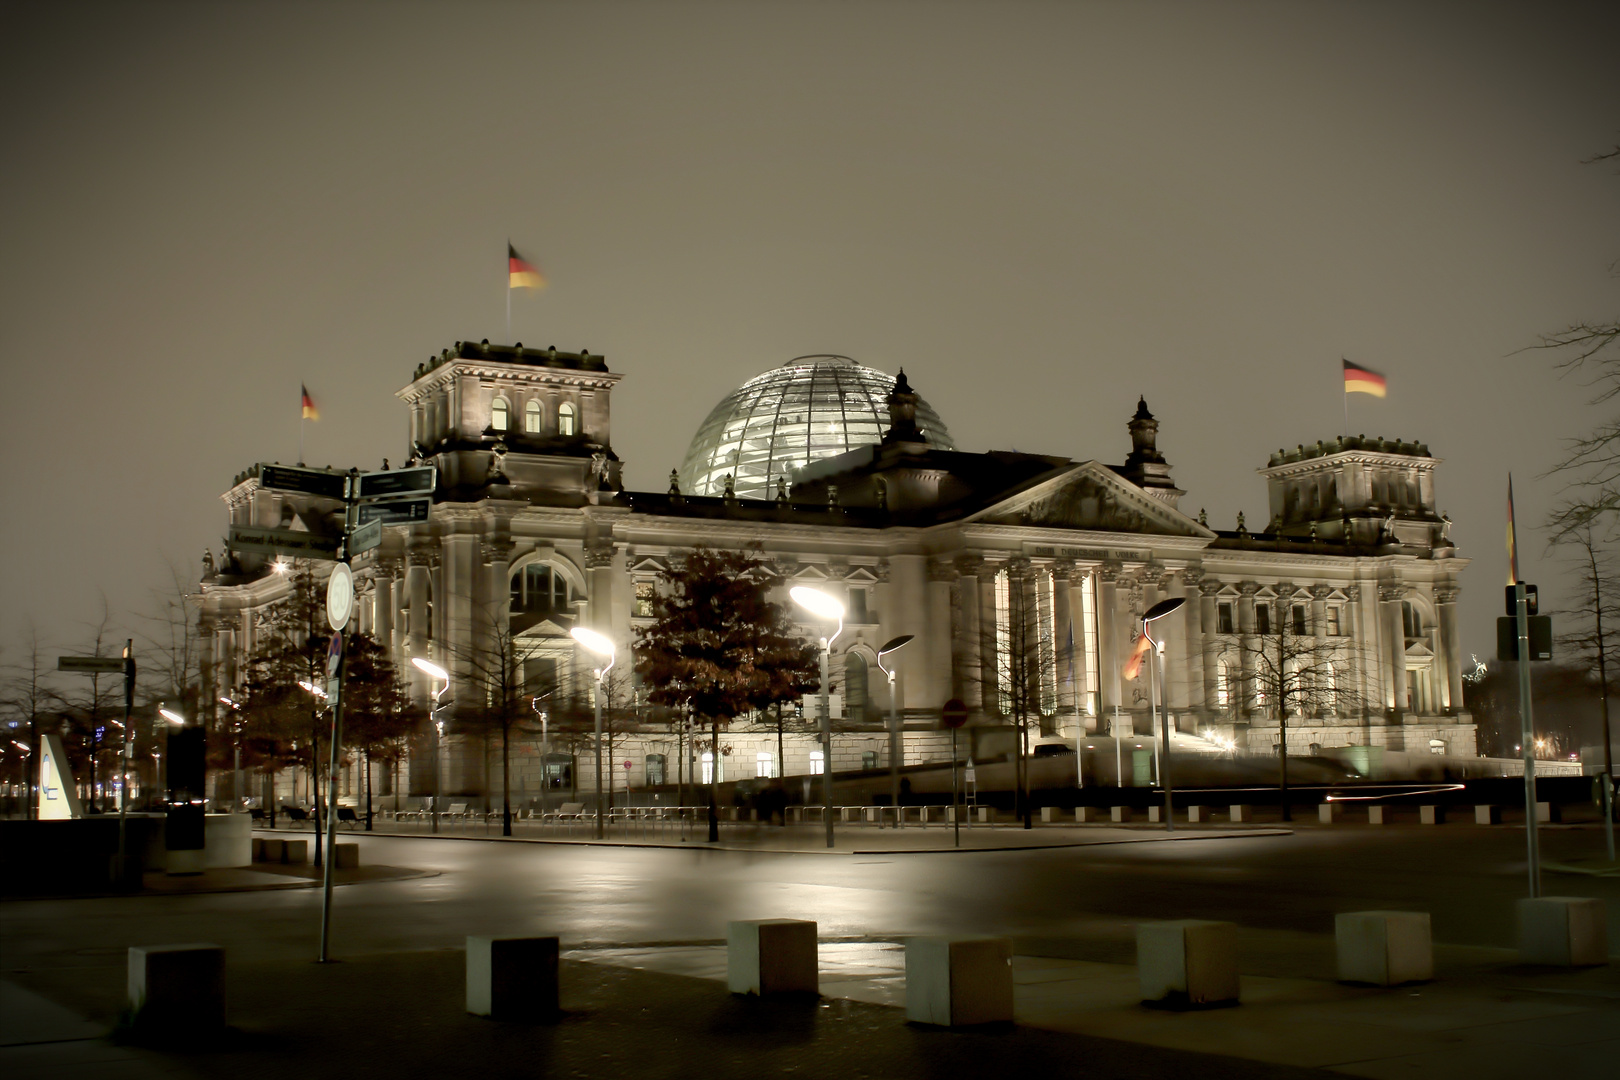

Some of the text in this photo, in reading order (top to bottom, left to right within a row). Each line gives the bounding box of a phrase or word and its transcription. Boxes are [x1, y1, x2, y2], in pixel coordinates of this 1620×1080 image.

[1036, 547, 1140, 559] DEM DEUTSCHEN VOLKE
[333, 582, 348, 611] 50
